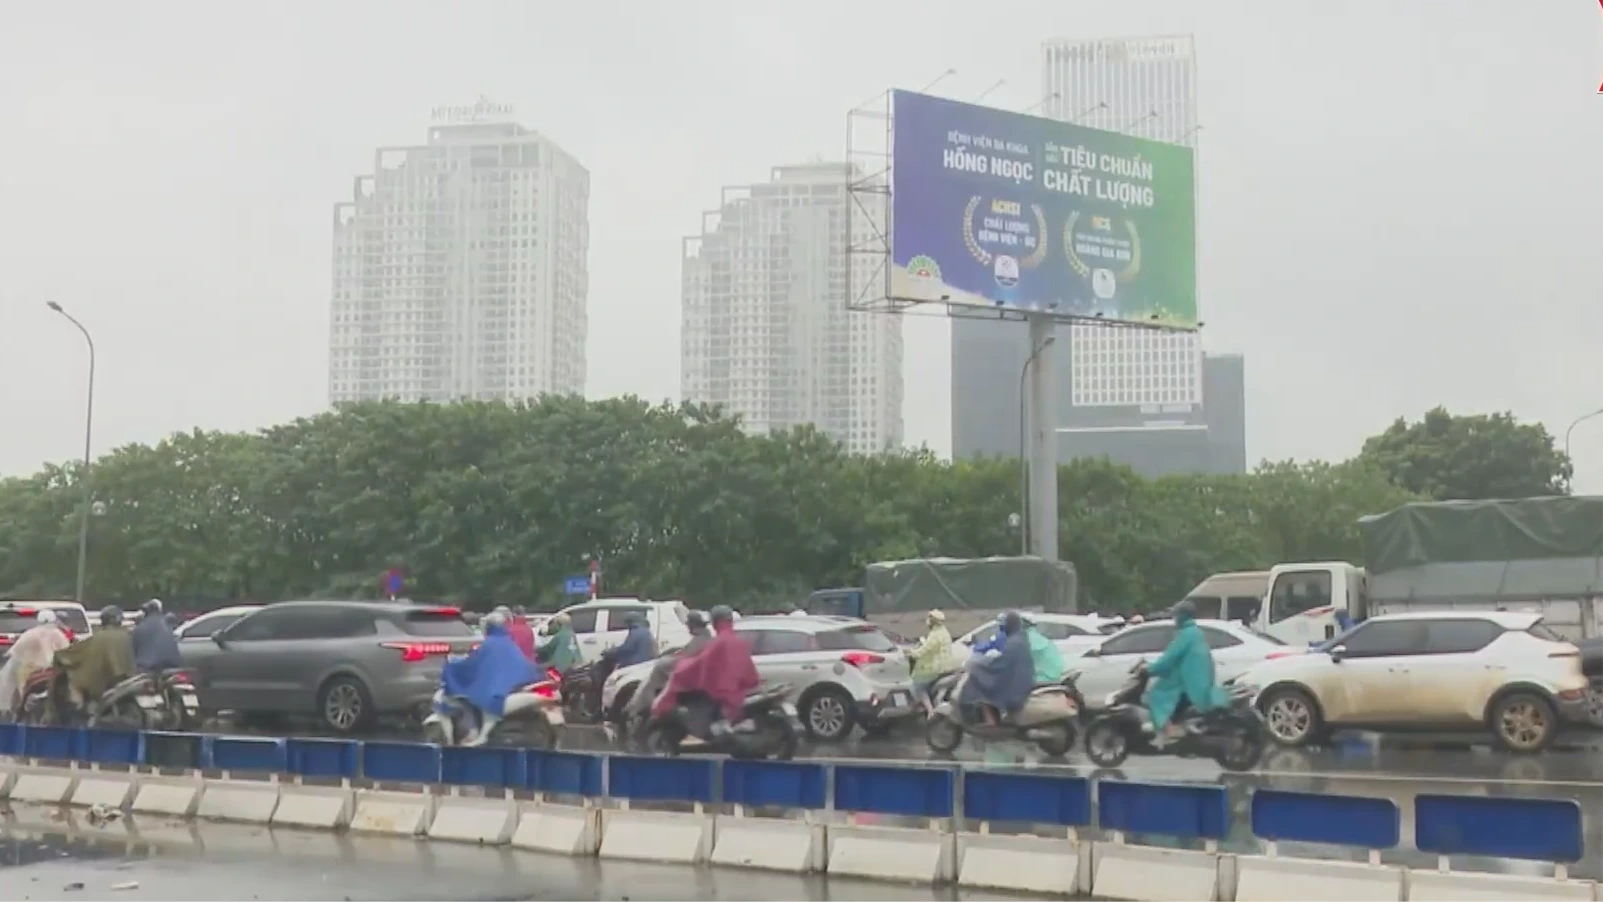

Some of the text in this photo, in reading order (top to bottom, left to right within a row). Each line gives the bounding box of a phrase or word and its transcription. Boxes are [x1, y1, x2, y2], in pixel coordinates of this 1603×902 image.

[991, 156, 1034, 184] NGỌC
[1060, 145, 1096, 170] TIÊU
[1096, 179, 1154, 209] LƯỢNG
